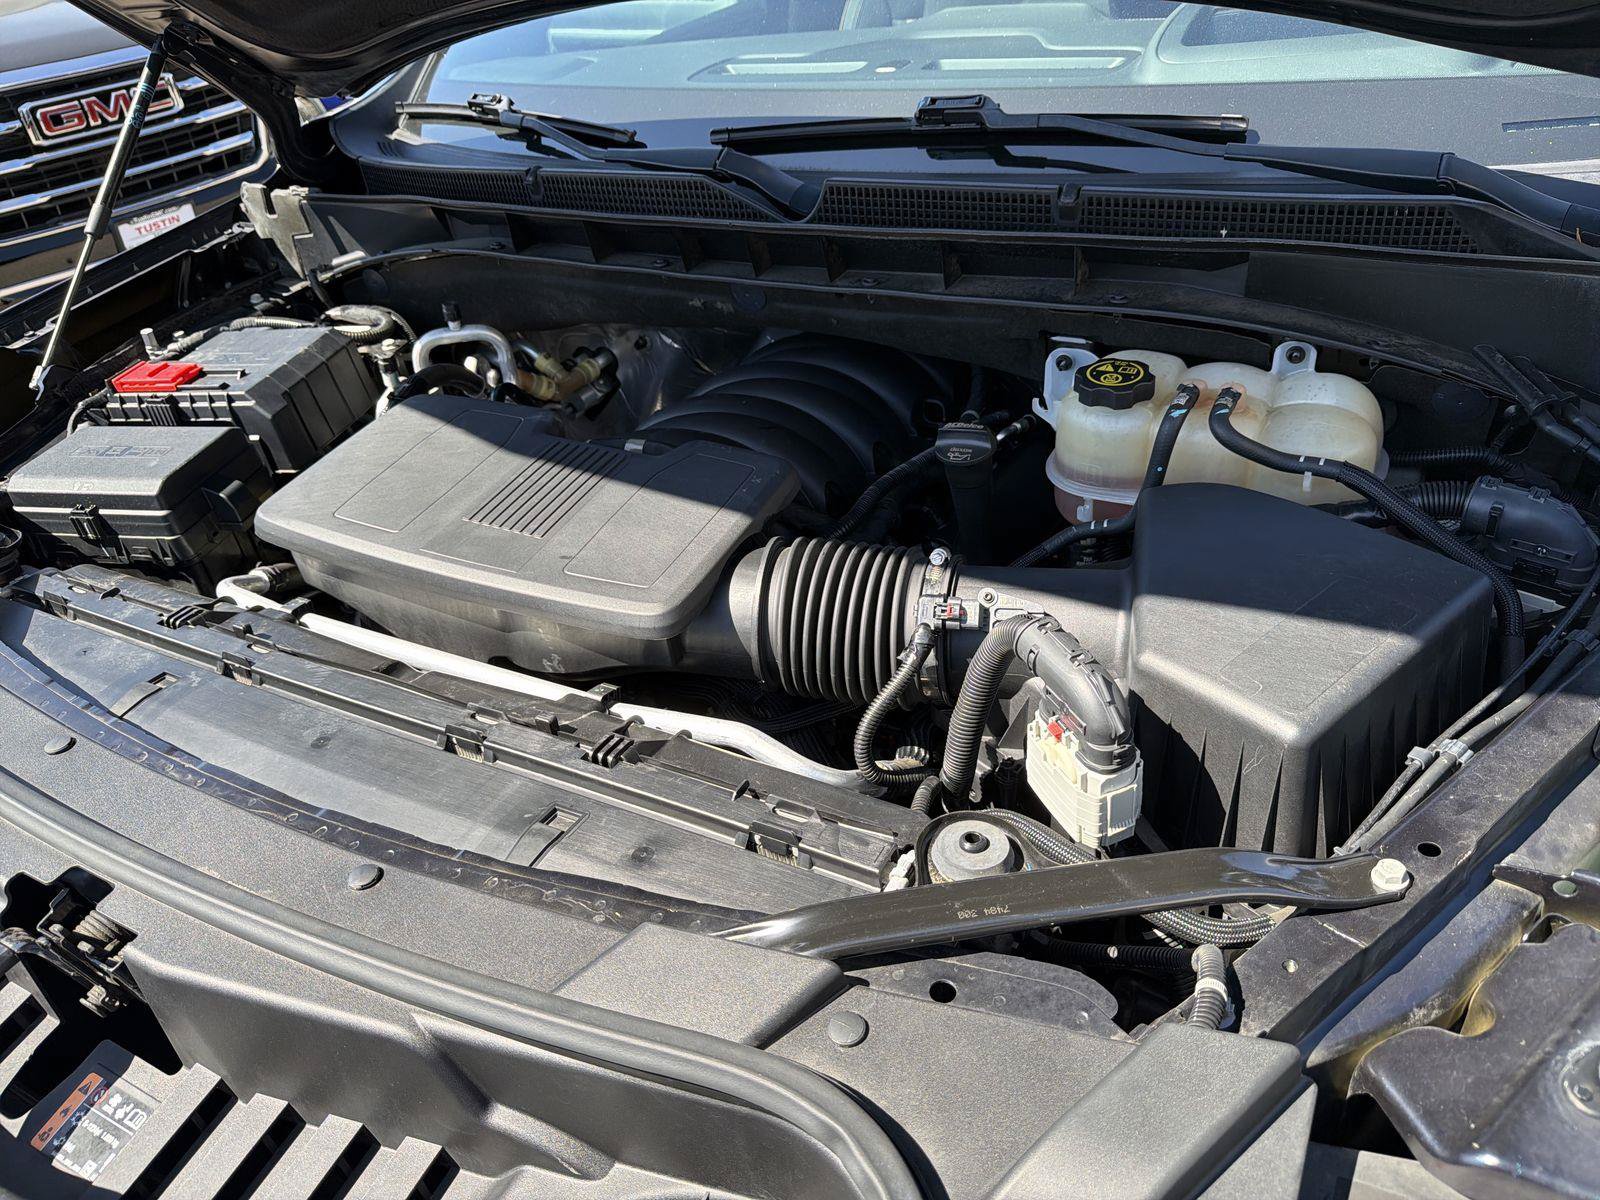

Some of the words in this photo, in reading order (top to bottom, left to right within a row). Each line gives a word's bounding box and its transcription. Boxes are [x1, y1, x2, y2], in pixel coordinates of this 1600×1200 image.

[36, 81, 175, 137] GMC
[135, 215, 181, 235] TUSTIN
[944, 422, 985, 430] ACDelco
